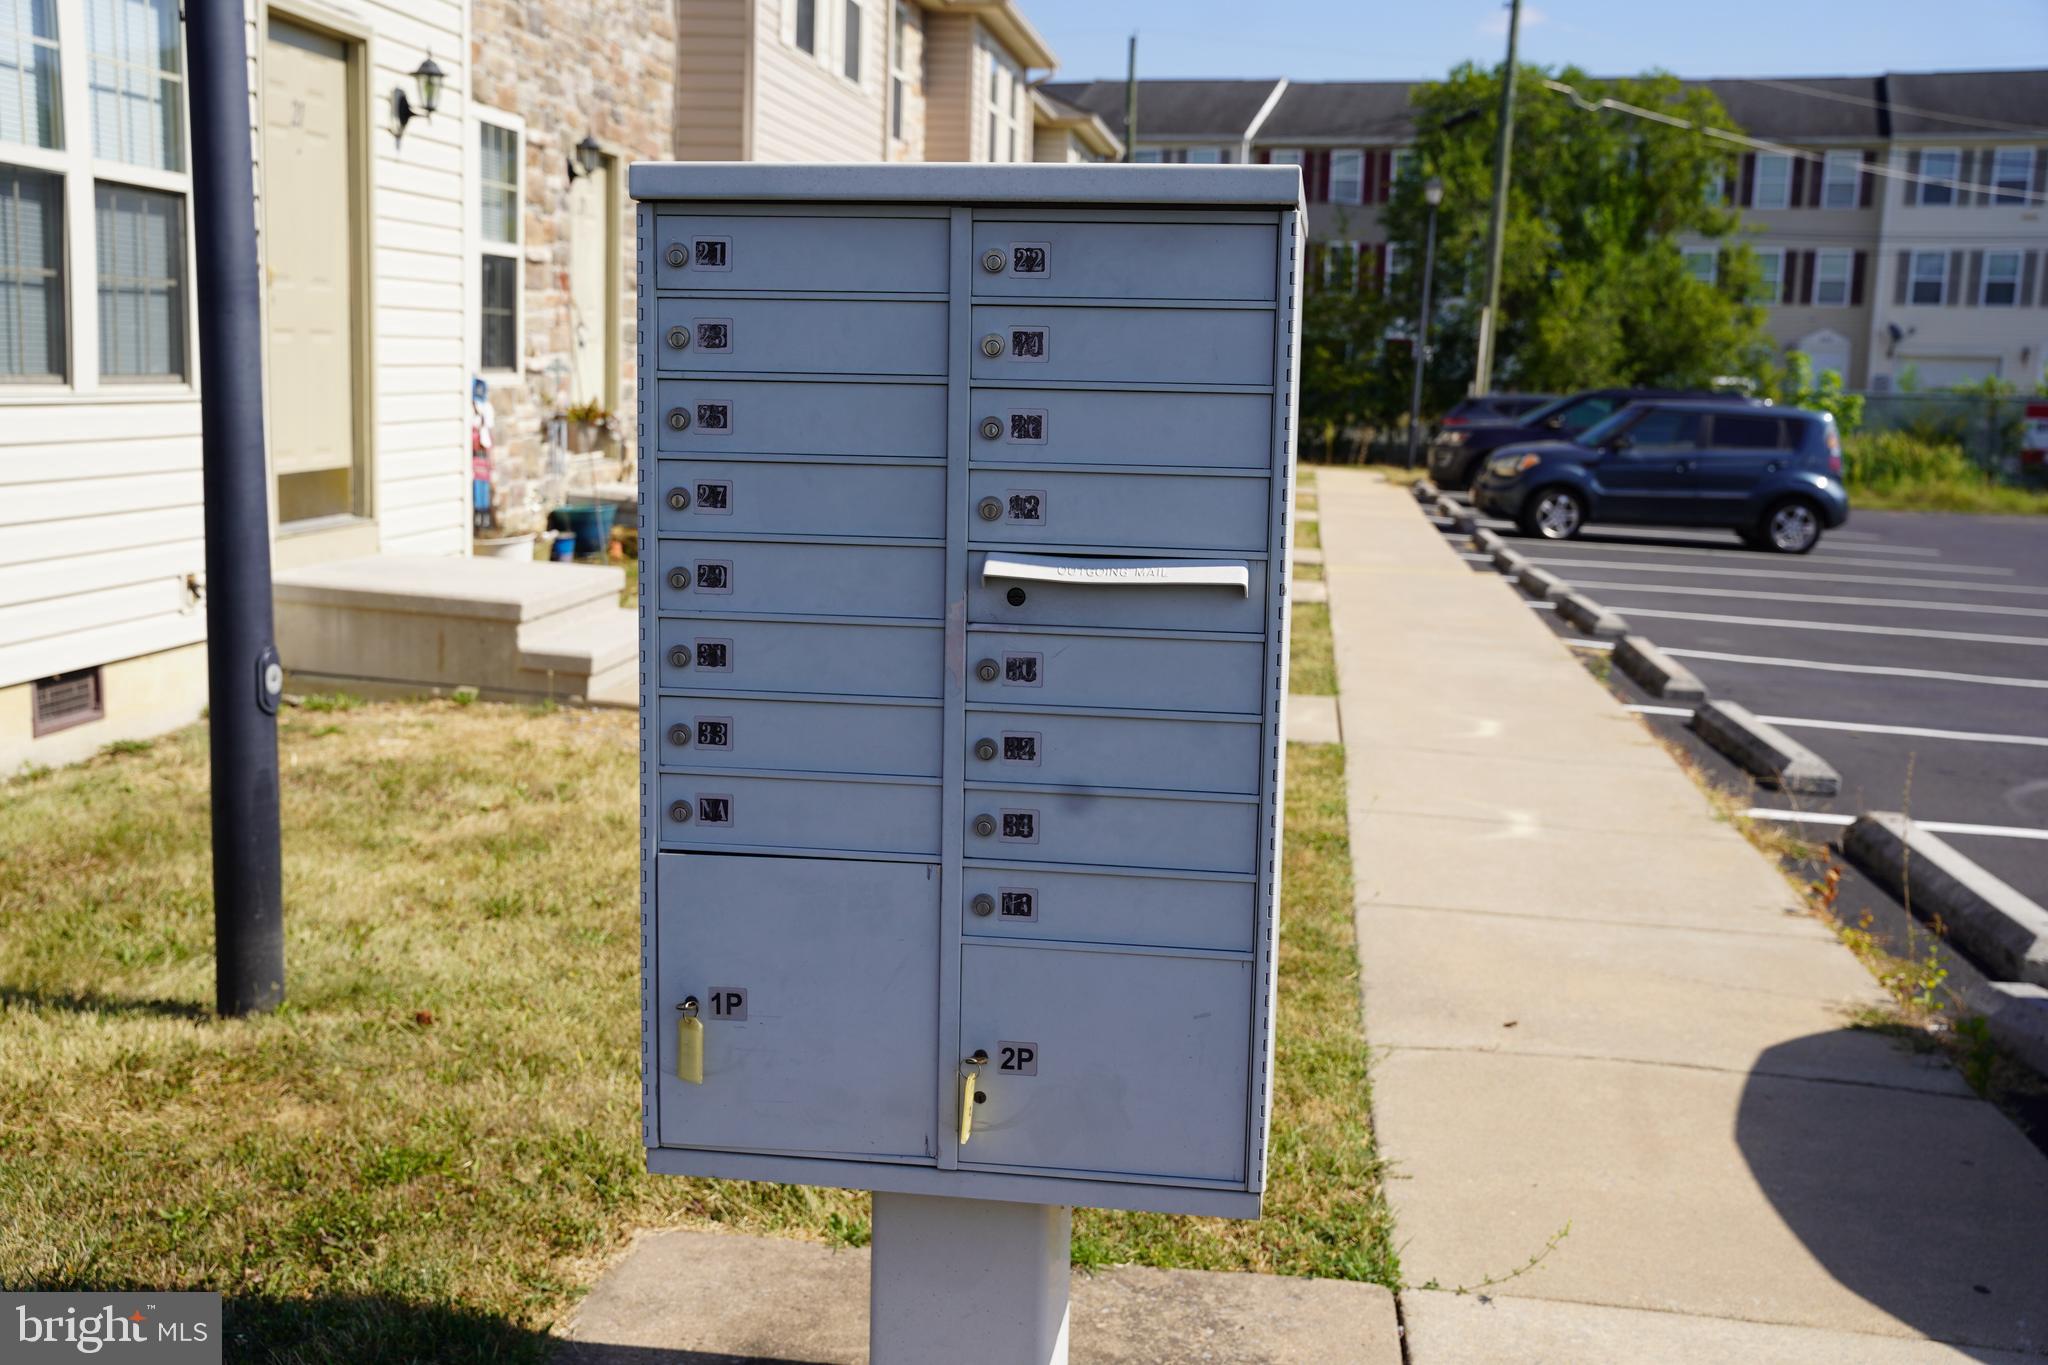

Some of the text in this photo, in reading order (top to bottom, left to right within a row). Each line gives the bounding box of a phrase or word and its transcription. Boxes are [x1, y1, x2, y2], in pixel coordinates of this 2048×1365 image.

[696, 241, 726, 266] 21
[1014, 248, 1045, 272] 22
[697, 484, 727, 508] 27
[697, 564, 727, 588] 29
[1057, 567, 1169, 578] OUTGOING MAIL
[698, 722, 727, 747] 33
[700, 798, 728, 823] NA
[1003, 814, 1033, 839] 34
[711, 992, 742, 1016] 1P
[1001, 1047, 1034, 1071] 2P
